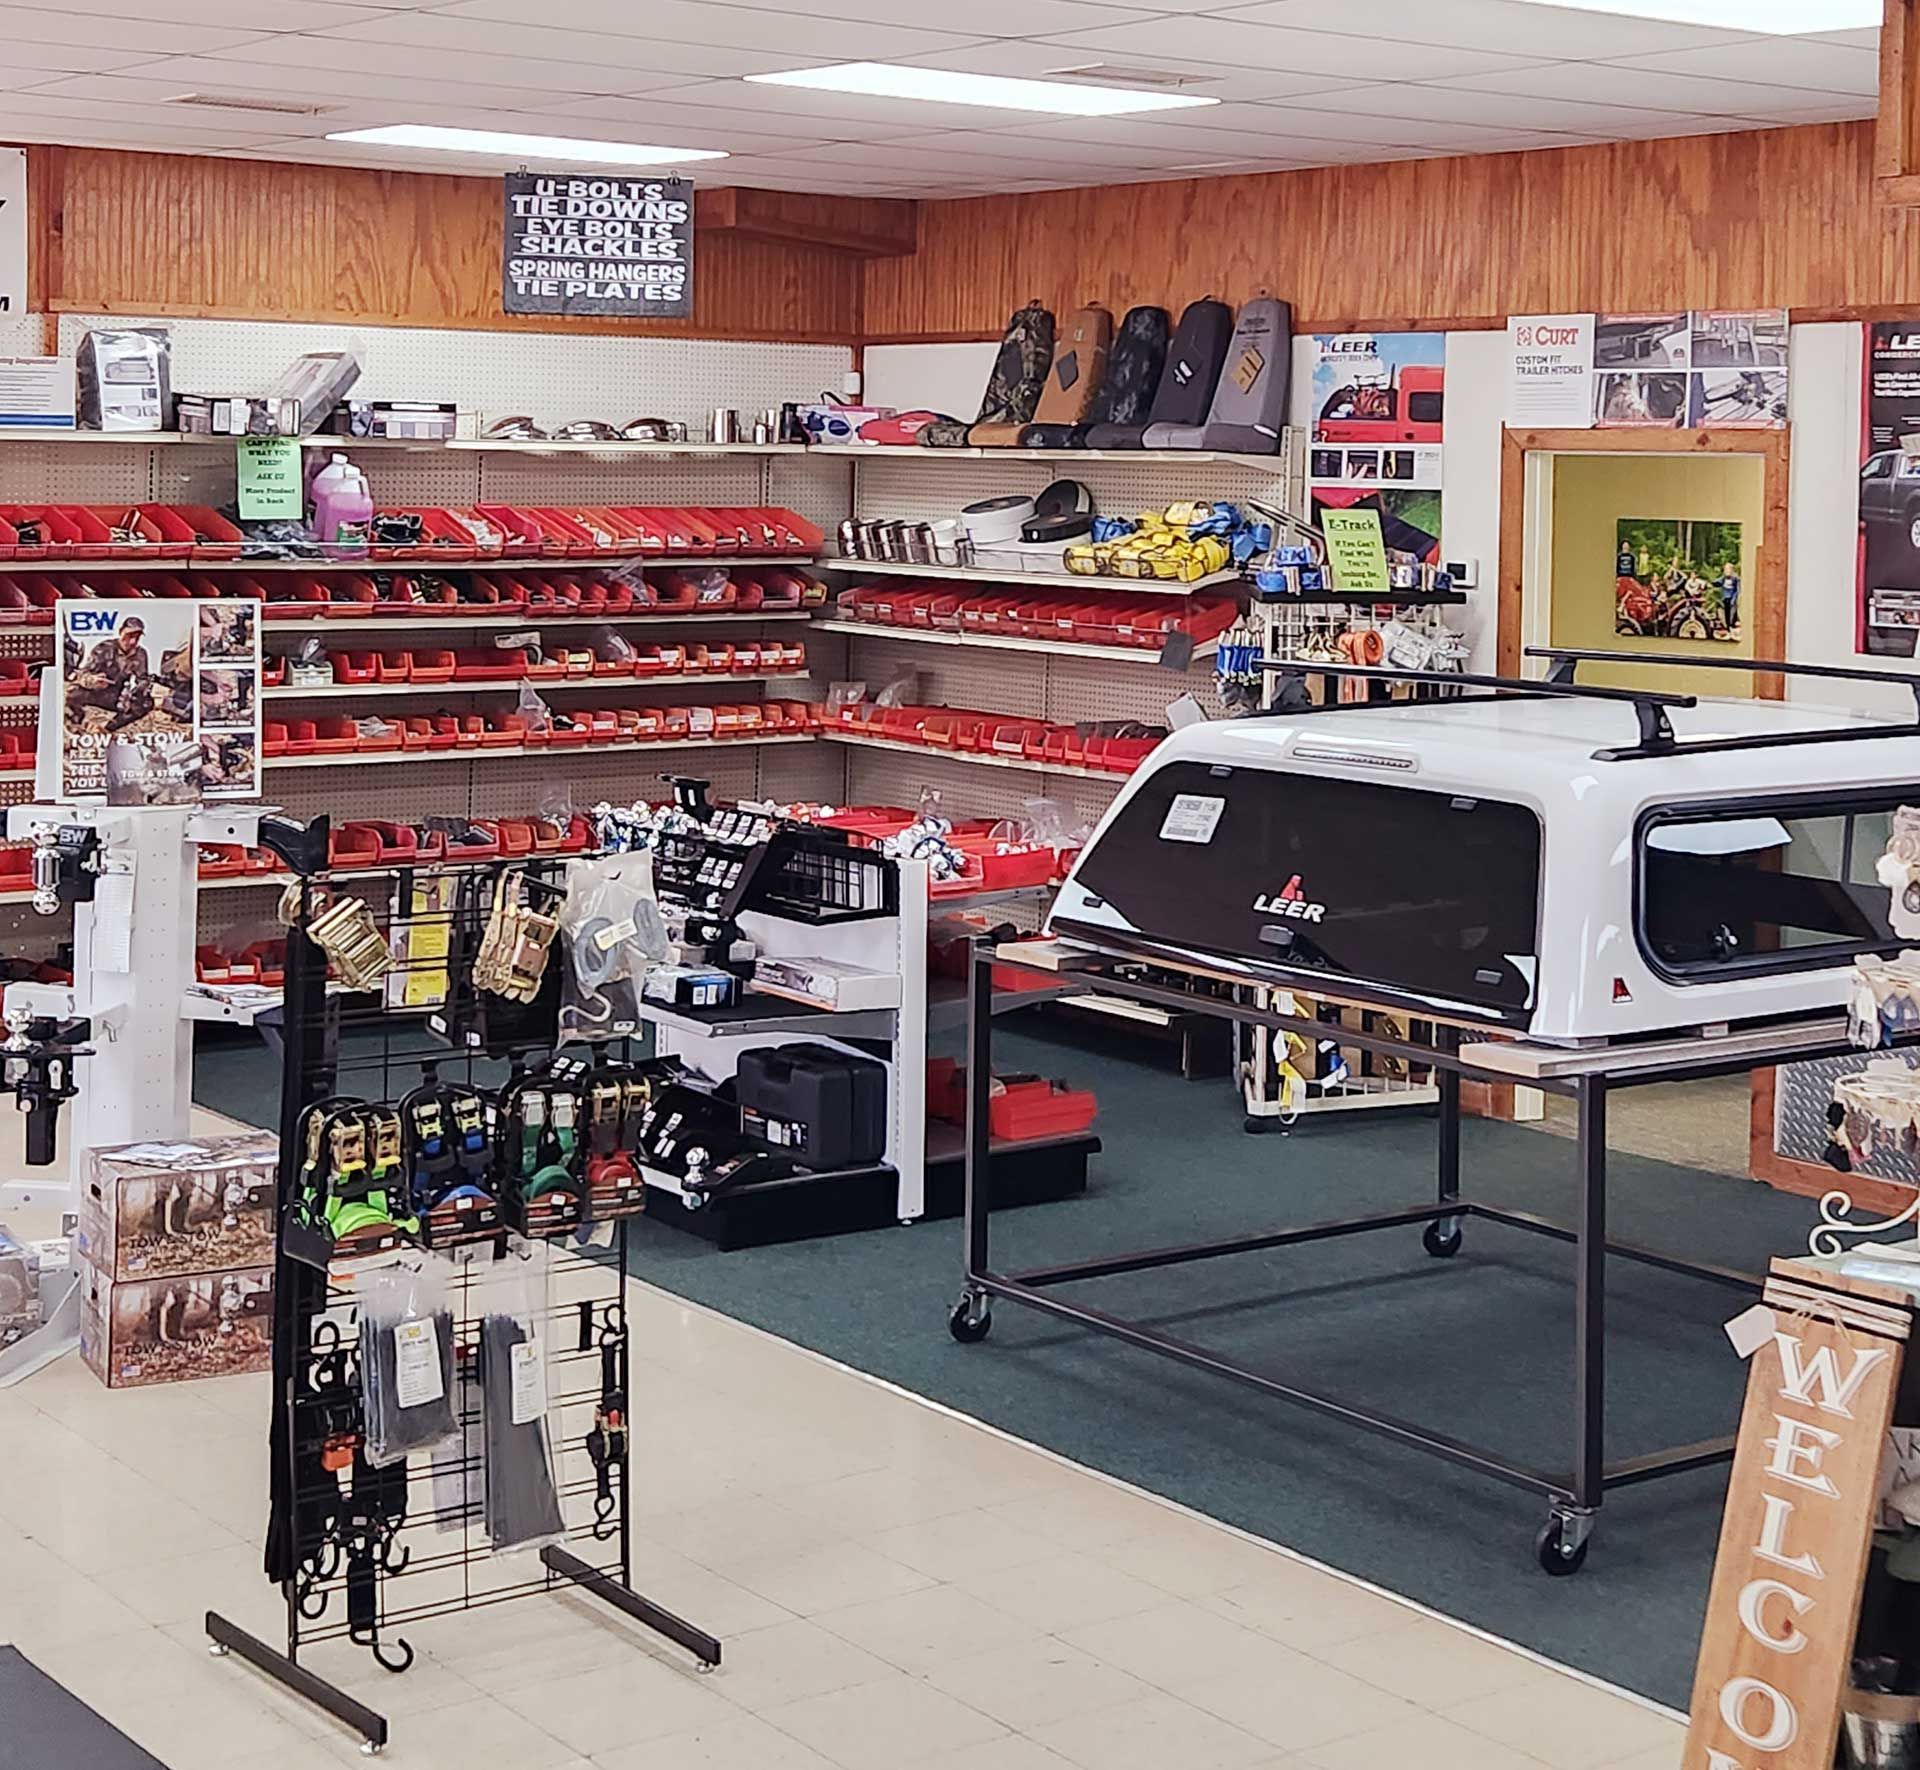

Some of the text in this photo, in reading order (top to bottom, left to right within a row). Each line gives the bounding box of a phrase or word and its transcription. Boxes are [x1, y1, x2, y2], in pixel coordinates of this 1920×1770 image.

[535, 179, 663, 201] U-BOLTS
[512, 195, 688, 222] TIE DOWNS
[527, 218, 673, 240] EYE BOLTS
[520, 237, 678, 259] SHACKLES
[509, 259, 686, 283] SPRING HANGERS
[513, 279, 682, 301] TIE PLATES
[1535, 326, 1579, 346] CURT
[1331, 341, 1378, 353] LEER
[1516, 355, 1562, 365] CUSTOM FIT
[1516, 365, 1584, 376] TRAILER HITCHES
[1327, 518, 1376, 530] E-Track
[70, 731, 186, 748] TOW & STOW
[69, 749, 107, 760] RECE
[69, 777, 108, 788] YOU'L
[120, 769, 144, 779] TOW
[1252, 893, 1326, 923] LEER
[129, 1236, 162, 1249] TOW
[180, 1230, 221, 1244] STOW
[124, 1341, 159, 1356] TOW
[175, 1335, 217, 1351] STOW
